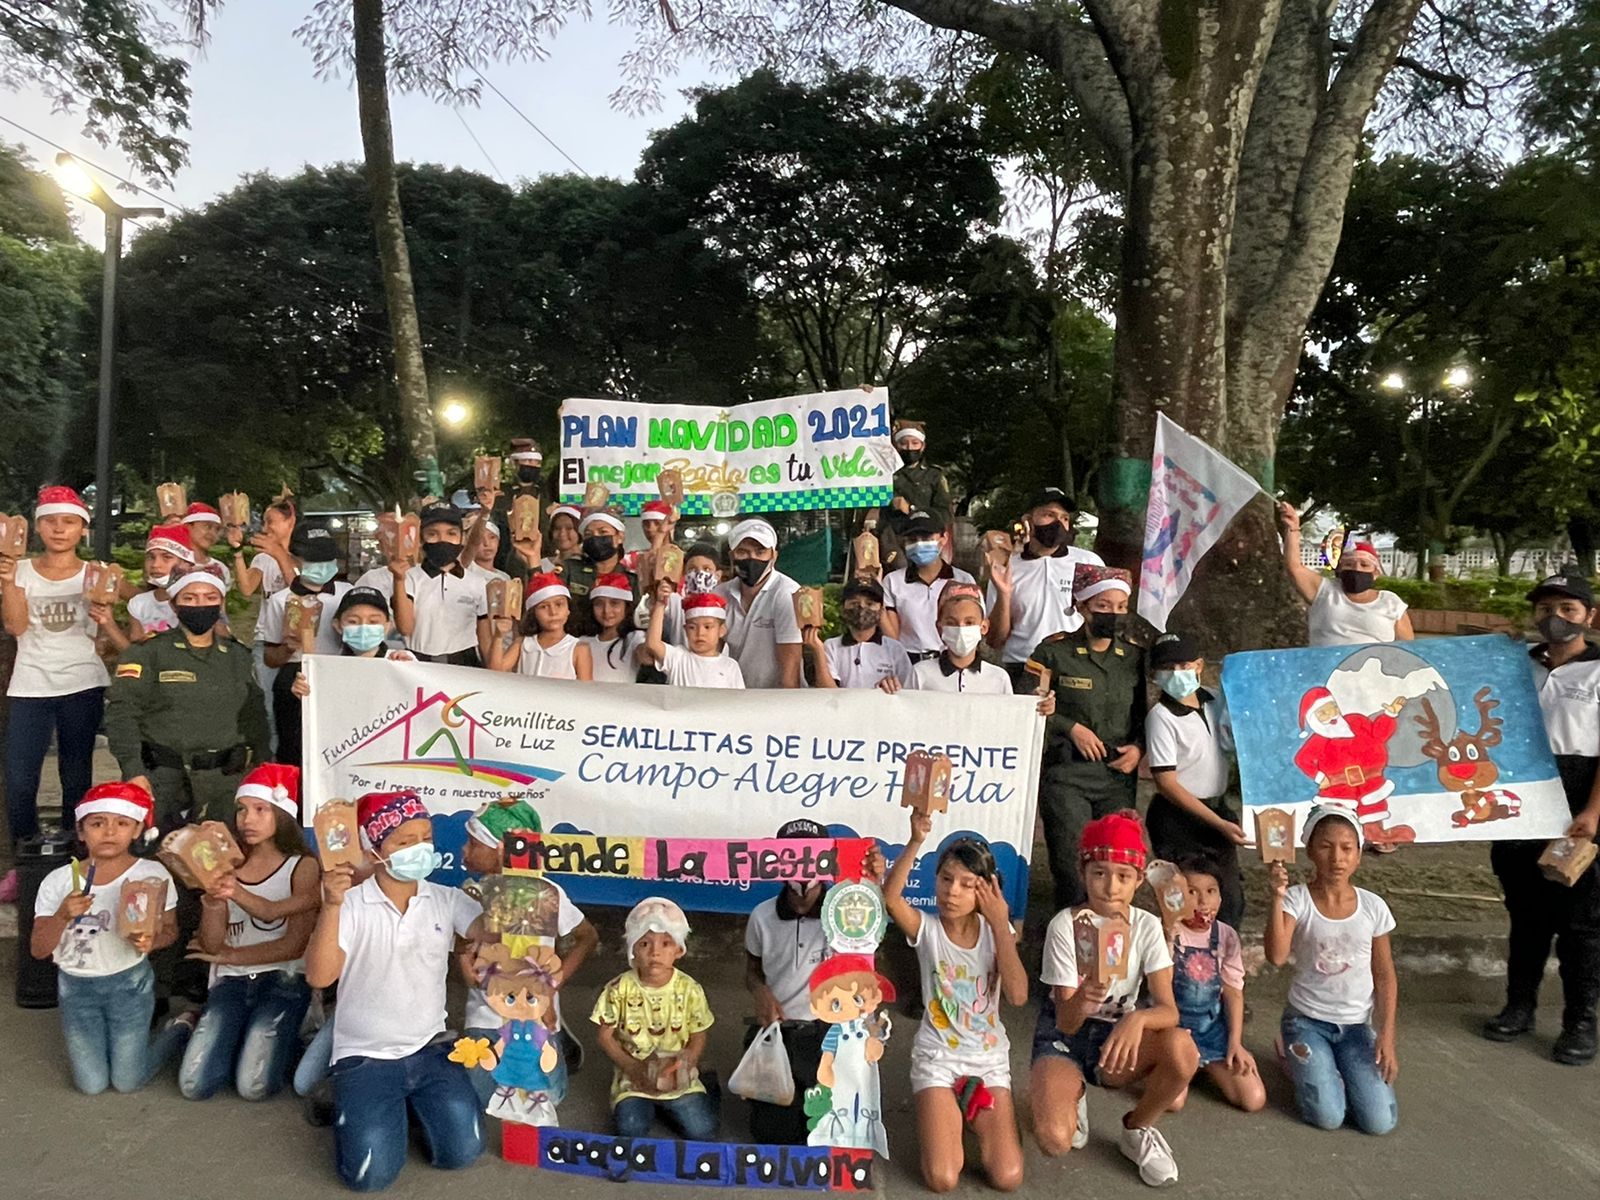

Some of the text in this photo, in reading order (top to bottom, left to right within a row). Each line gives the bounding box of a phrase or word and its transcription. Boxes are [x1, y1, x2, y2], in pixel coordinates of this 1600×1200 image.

[563, 415, 637, 448] PLAN
[808, 403, 889, 443] 2021
[563, 458, 585, 484] El
[749, 463, 781, 484] es
[786, 453, 815, 482] tu
[321, 701, 409, 765] Fundación
[480, 710, 576, 732] Semillitas
[495, 734, 556, 751] De Luz
[581, 724, 753, 755] SEMILLITAS
[766, 734, 801, 759] DE
[812, 737, 866, 762] LUZ
[375, 780, 386, 790] el
[439, 788, 447, 796] a
[452, 788, 501, 799] nuestros
[578, 752, 729, 799] Campo
[733, 759, 878, 808] Alegre
[503, 832, 839, 879] Prende La Fiesta
[675, 1140, 721, 1180] La
[735, 1146, 875, 1190] Polvora
